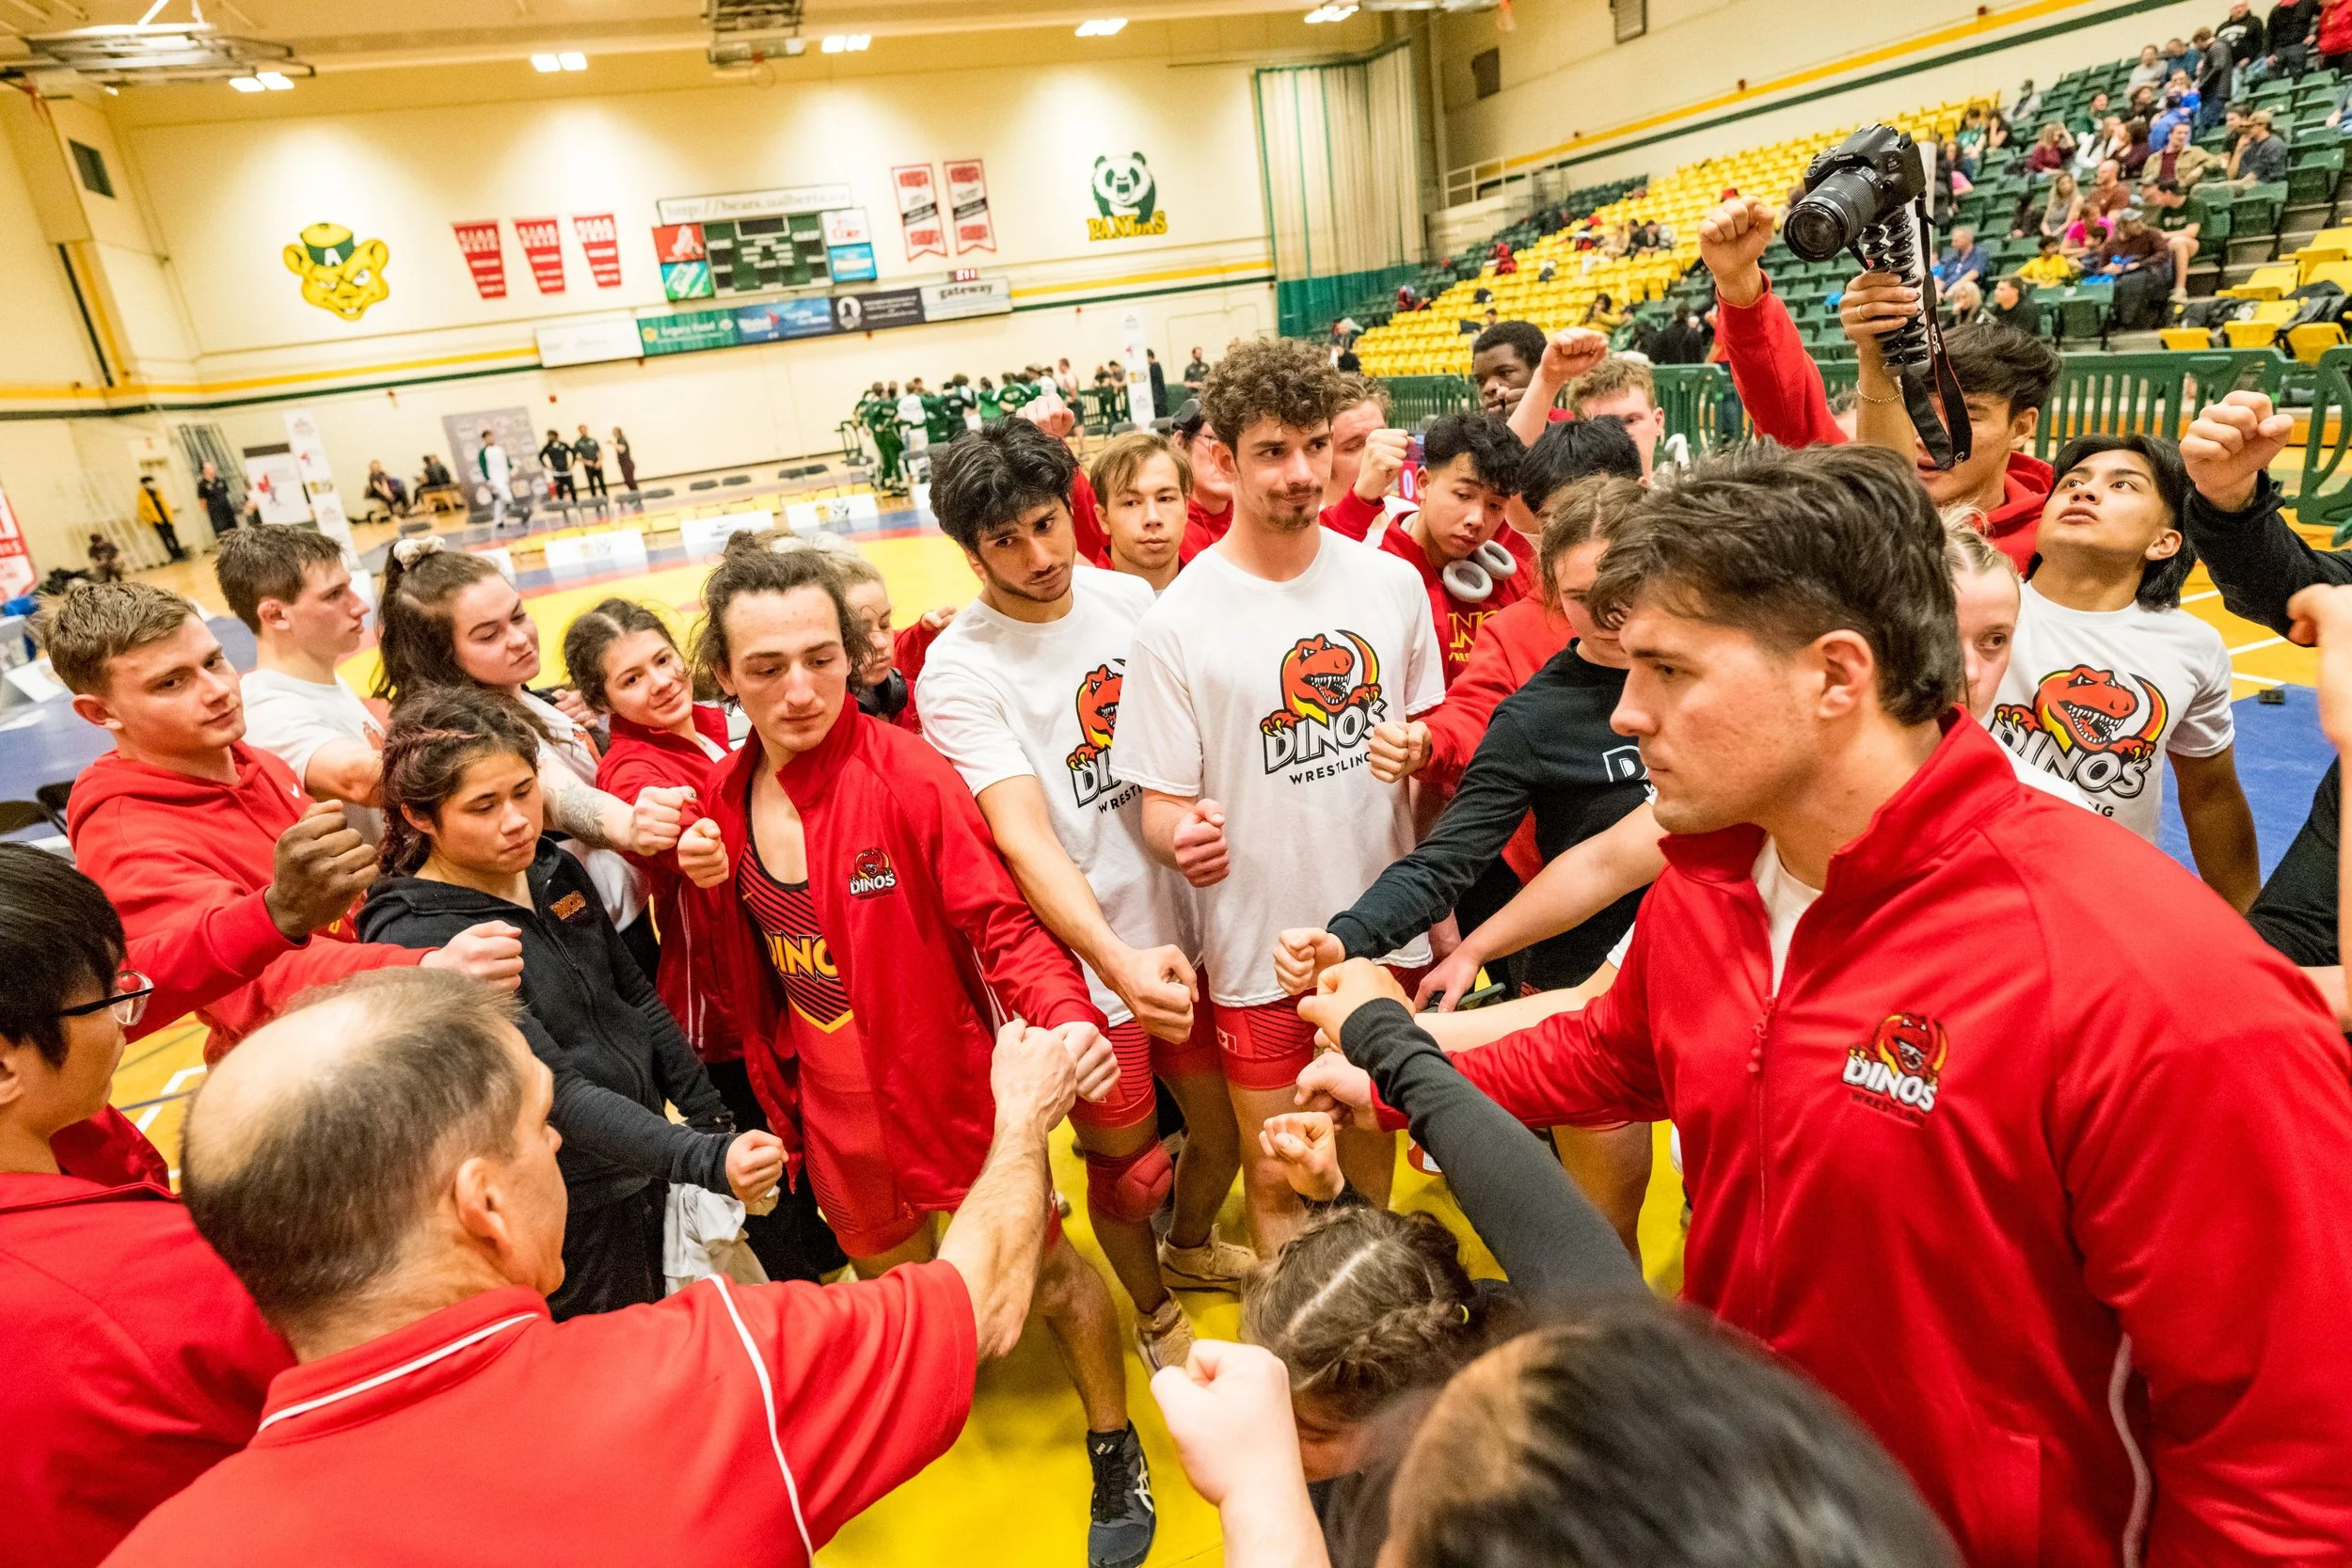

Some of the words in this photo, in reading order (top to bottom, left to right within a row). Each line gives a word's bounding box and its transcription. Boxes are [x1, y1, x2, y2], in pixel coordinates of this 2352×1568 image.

[1834, 153, 1853, 162] Canon
[1086, 210, 1168, 241] PANDAS
[939, 284, 993, 300] gateway
[849, 873, 897, 895] DINOS
[1841, 1054, 1939, 1113] DINOS
